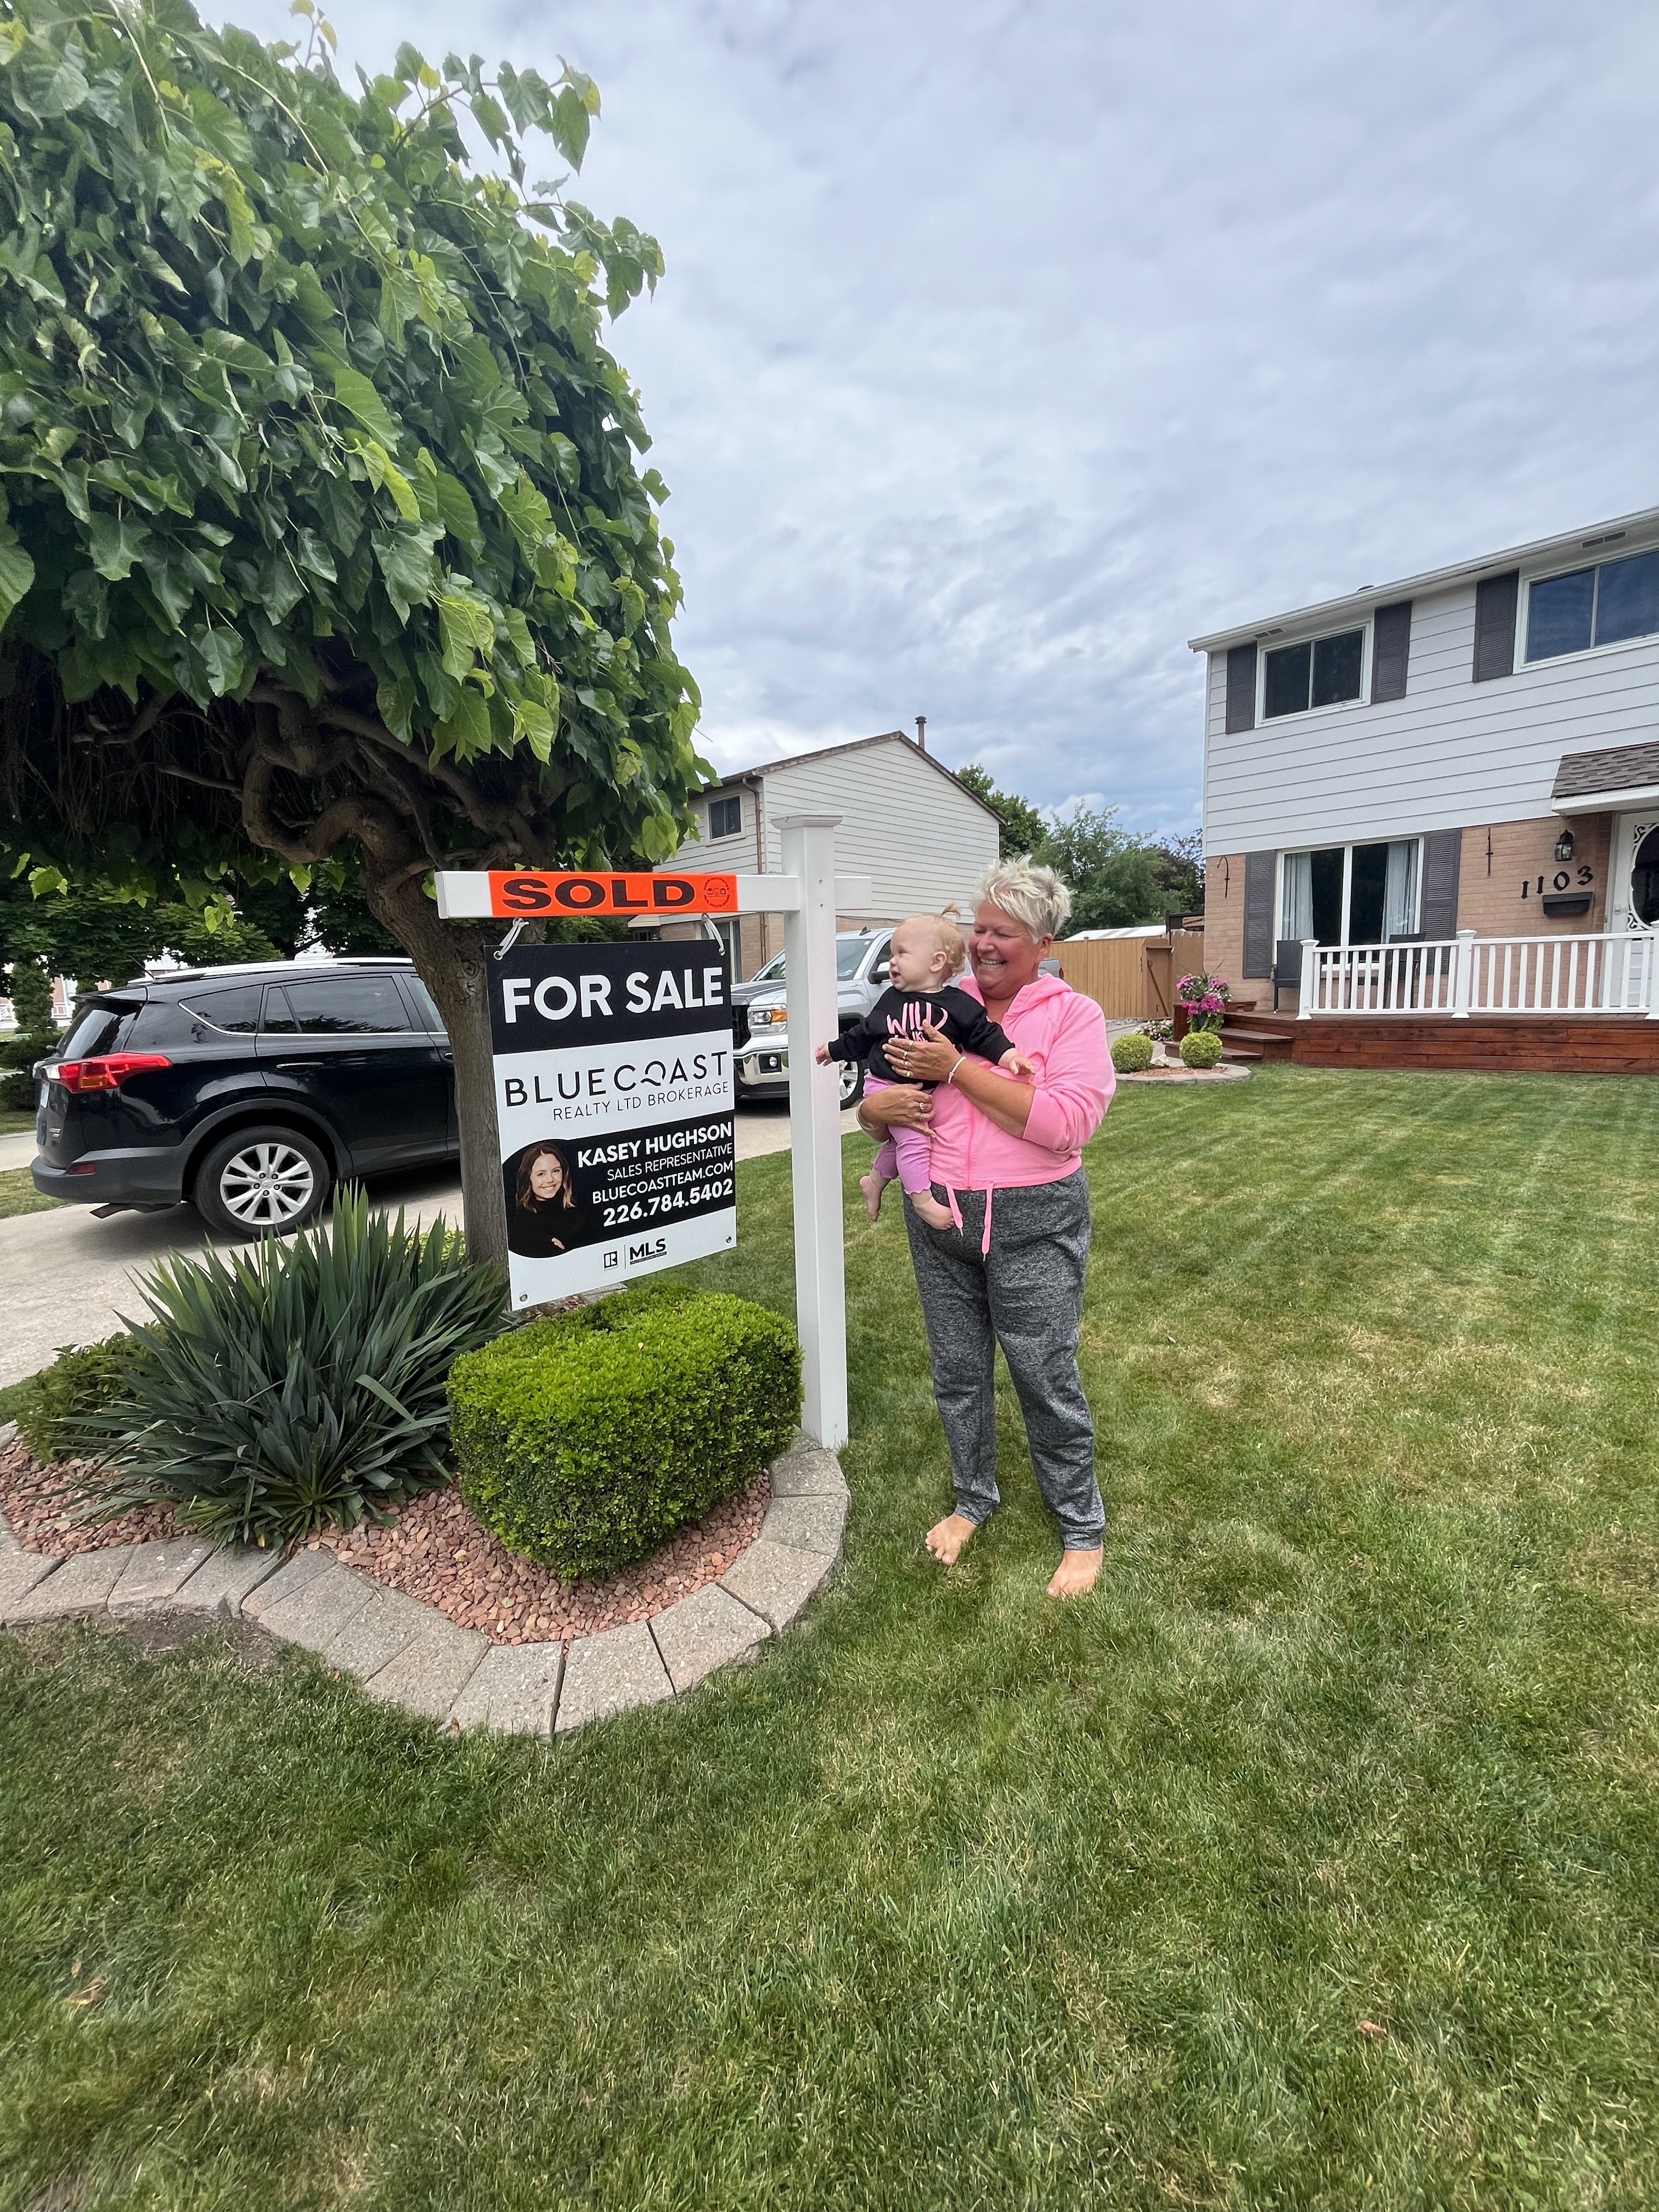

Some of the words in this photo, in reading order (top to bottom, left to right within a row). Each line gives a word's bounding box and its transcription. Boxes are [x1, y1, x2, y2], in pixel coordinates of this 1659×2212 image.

[502, 878, 695, 910] SOLD
[1521, 865, 1593, 899] 1103
[503, 974, 613, 1023] FOR
[625, 967, 724, 1014] SALE
[886, 1001, 948, 1036] WILD
[505, 1051, 727, 1107] BLUECOAST
[553, 1101, 611, 1121] REALTY
[617, 1097, 641, 1111] LTD
[648, 1081, 729, 1105] BROKERAGE
[578, 1140, 641, 1168] KASEY
[646, 1121, 732, 1155] HUGHSON
[607, 1163, 642, 1181] SALES
[645, 1143, 732, 1173] REPRESENTATIVE
[592, 1159, 733, 1204] BLUECOASTTEAM.COM
[603, 1178, 733, 1227] 226.784.5402
[629, 1238, 666, 1260] MLS
